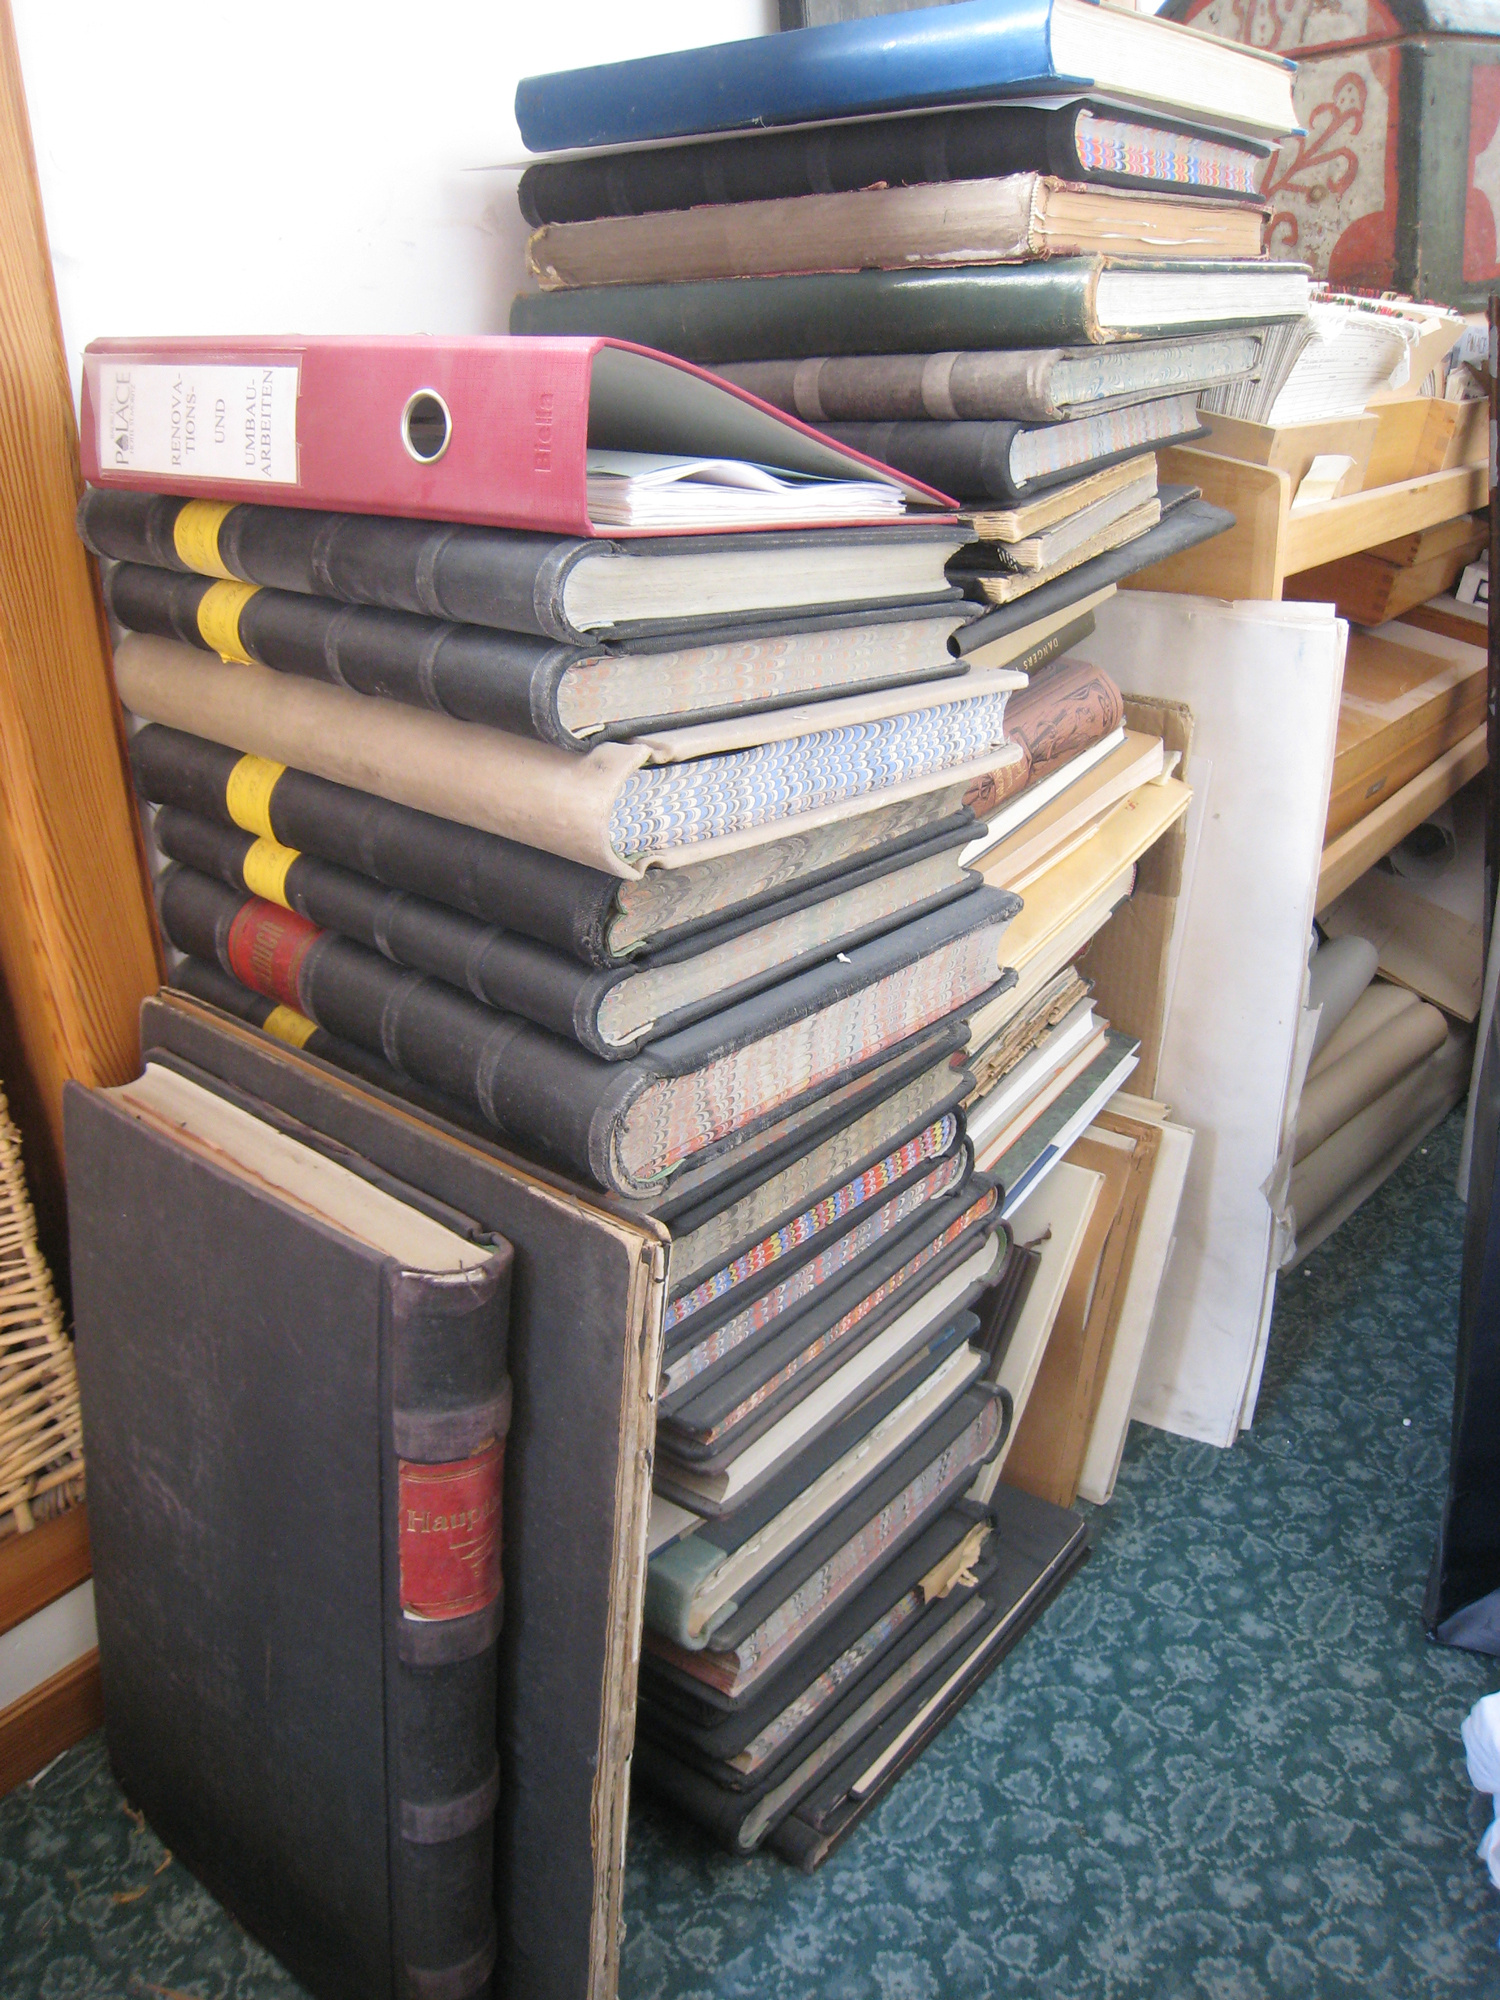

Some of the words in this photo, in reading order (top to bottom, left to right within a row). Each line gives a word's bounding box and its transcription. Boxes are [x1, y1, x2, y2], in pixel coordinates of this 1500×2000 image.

[171, 372, 183, 466] RENOVA-
[185, 386, 197, 455] TIONS-
[214, 398, 226, 444] UND
[245, 378, 257, 466] UMBAU-
[260, 369, 274, 478] ARBEITEN
[1023, 637, 1059, 671] DANGERS
